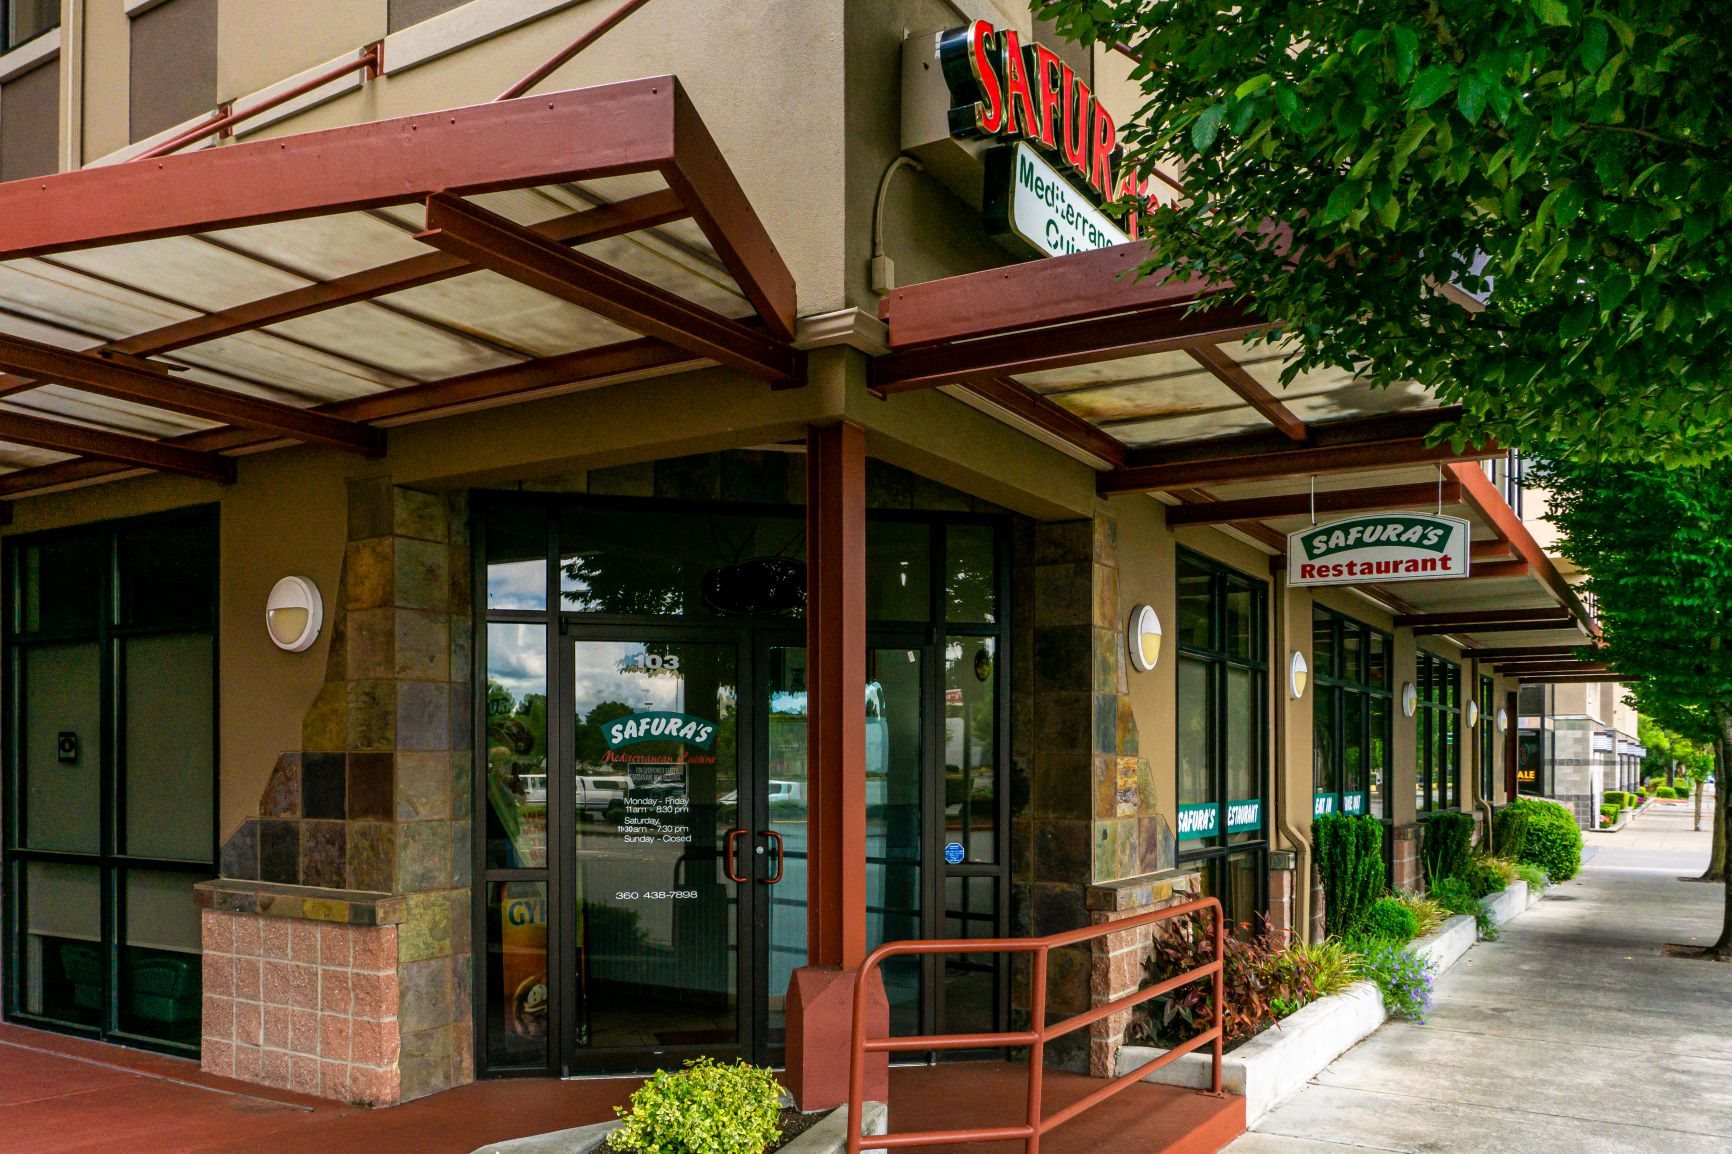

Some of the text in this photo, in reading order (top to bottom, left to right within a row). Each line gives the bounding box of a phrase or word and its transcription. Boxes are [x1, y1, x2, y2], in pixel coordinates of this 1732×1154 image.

[1312, 523, 1444, 555] SAFURA'S
[1300, 554, 1452, 579] Restaurant
[634, 654, 680, 669] 103
[611, 718, 713, 744] SAFURA'S
[624, 797, 657, 806] Monday
[665, 797, 690, 806] Friday
[1178, 803, 1259, 833] SAFURA'S ESTAURANT
[624, 835, 655, 844] Sunday
[662, 834, 692, 843] Closed
[615, 890, 698, 900] 360 438-7898
